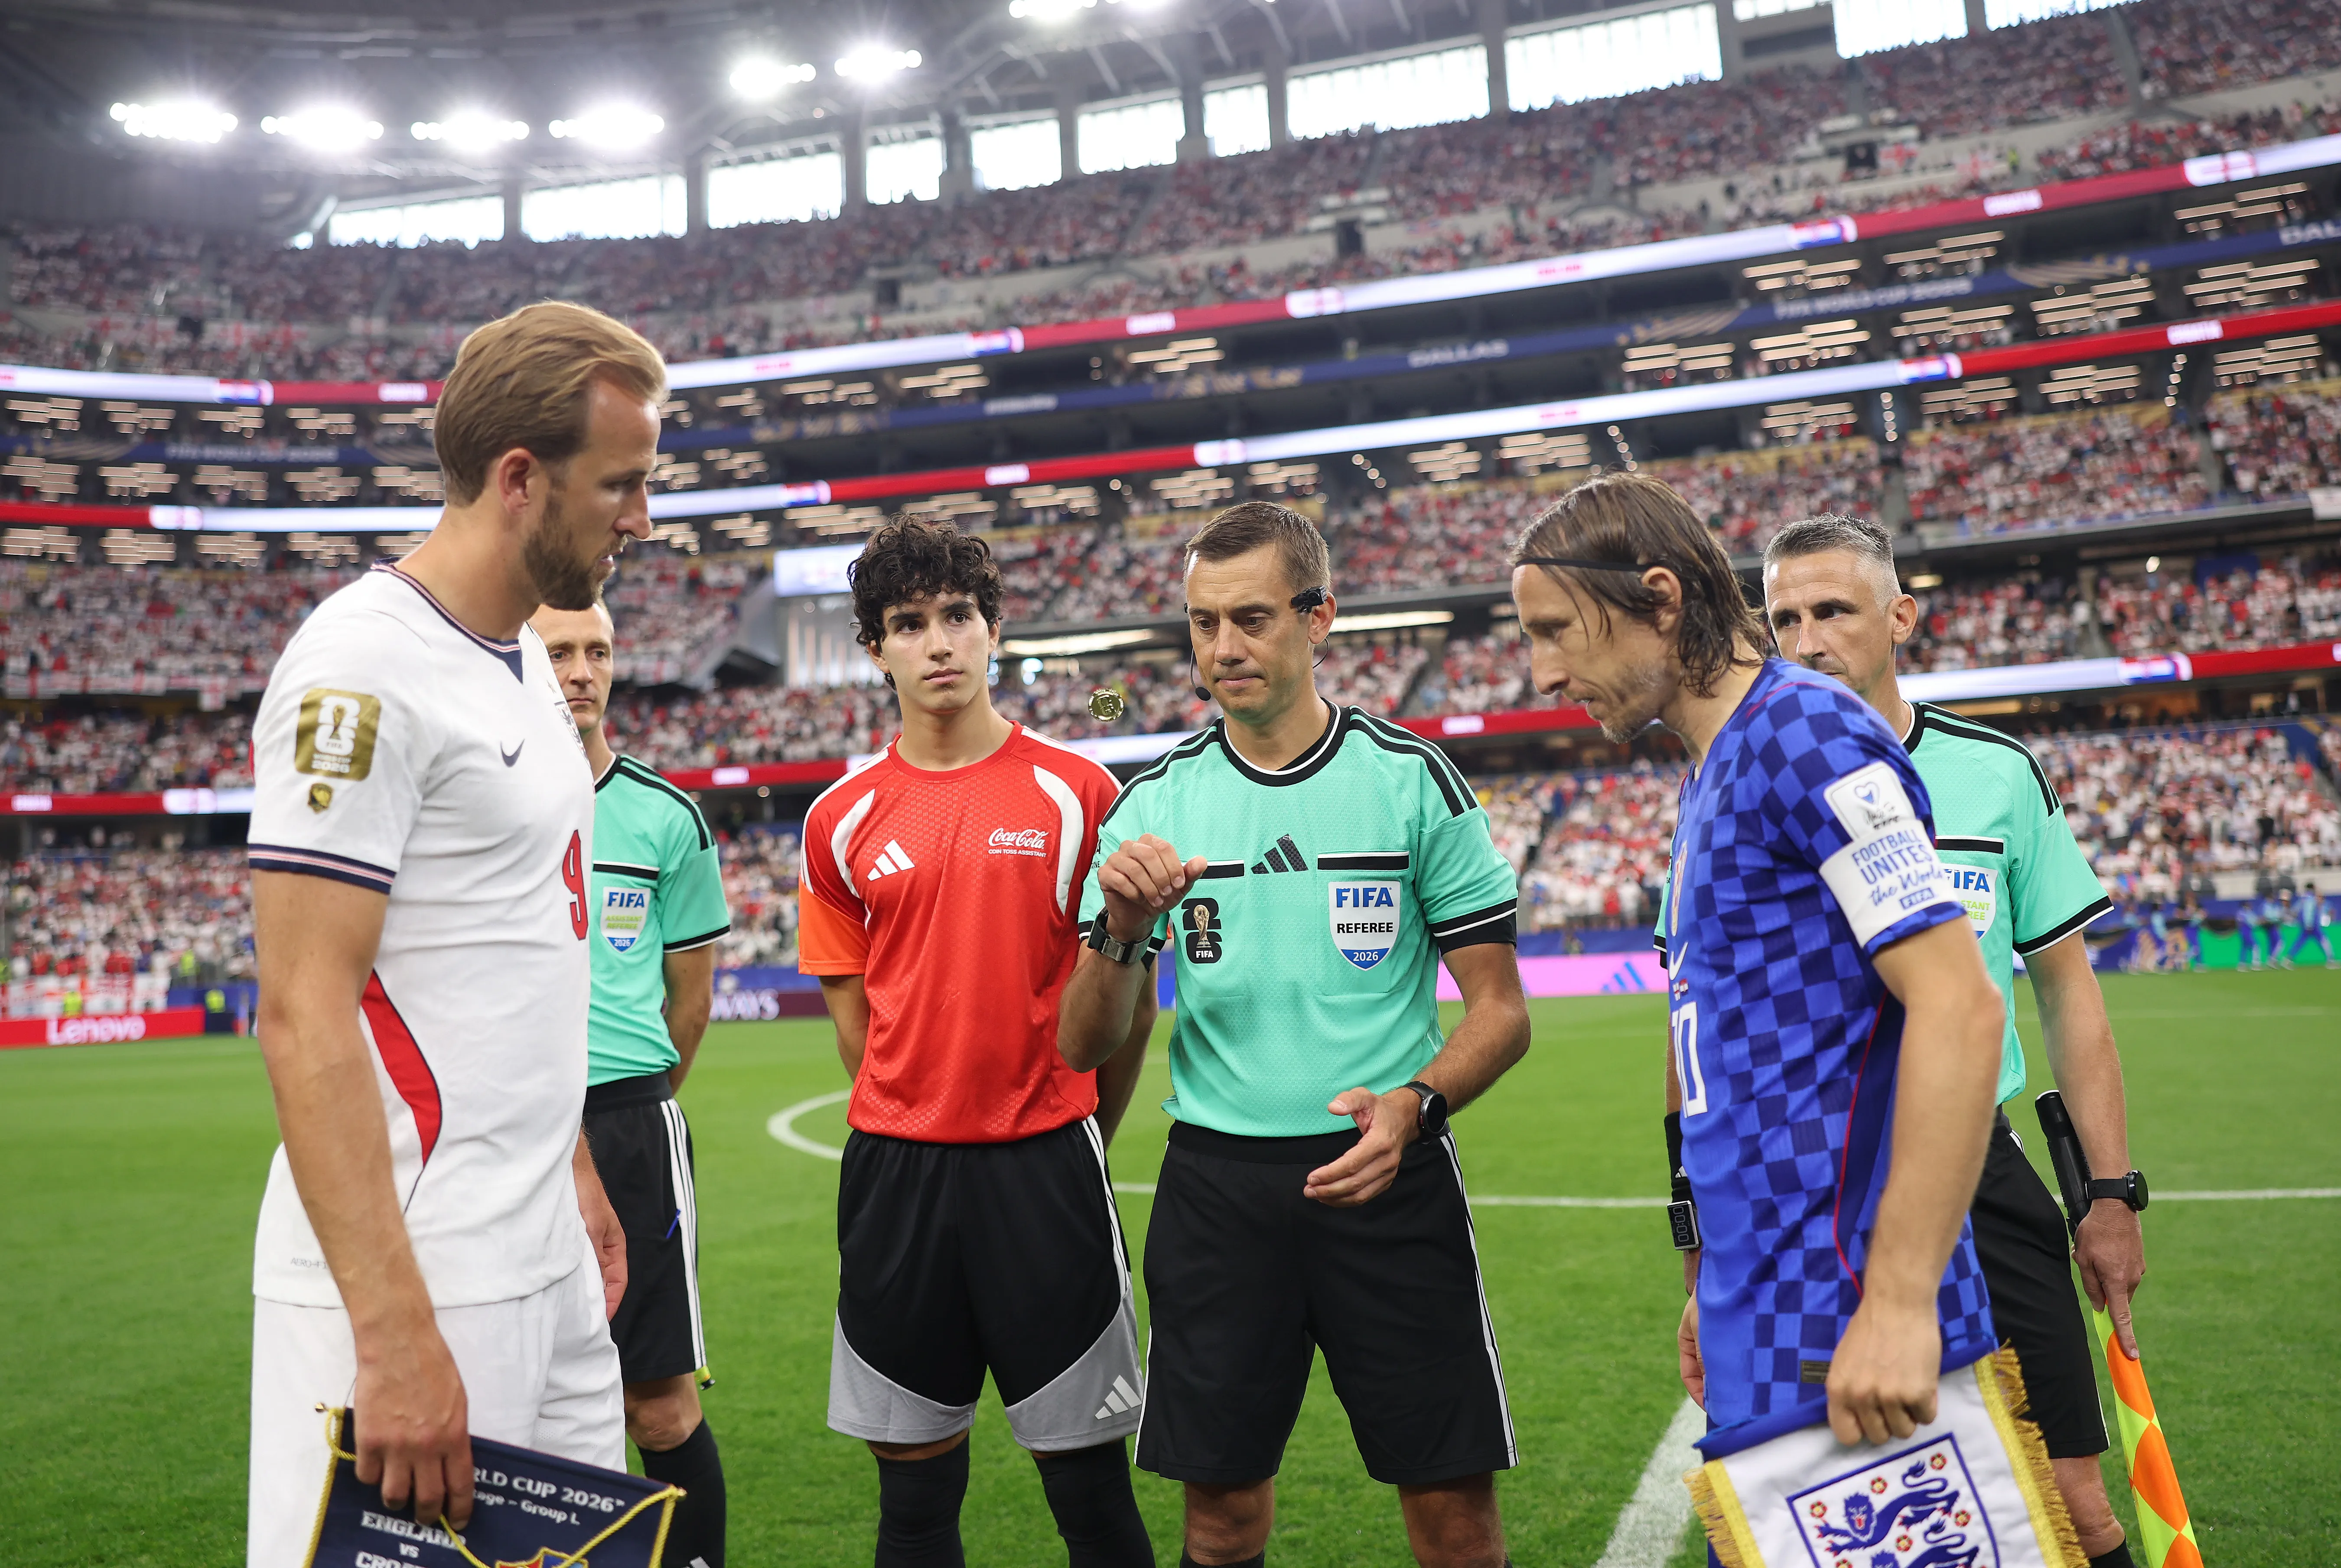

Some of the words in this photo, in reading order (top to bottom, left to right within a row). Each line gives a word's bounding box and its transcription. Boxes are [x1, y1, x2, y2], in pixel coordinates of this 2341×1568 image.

[1407, 338, 1509, 368] DALLAS
[988, 828, 1049, 849] Coca-Cola
[1852, 829, 1921, 866] FOOTBALL
[1018, 849, 1047, 858] ASSISTANT
[1860, 844, 1933, 885] UNITES
[562, 829, 588, 941] 9
[1869, 885, 1898, 906] the
[1337, 922, 1394, 934] REFEREE
[614, 939, 631, 947] 2026
[1353, 952, 1379, 962] 2026
[46, 1015, 147, 1046] Lenovo
[1672, 1002, 1708, 1118] 10
[290, 1257, 326, 1269] AERO-FI
[474, 1467, 508, 1487] RLD
[512, 1476, 557, 1498] CUP
[521, 1499, 568, 1524] Group
[570, 1511, 581, 1526] L
